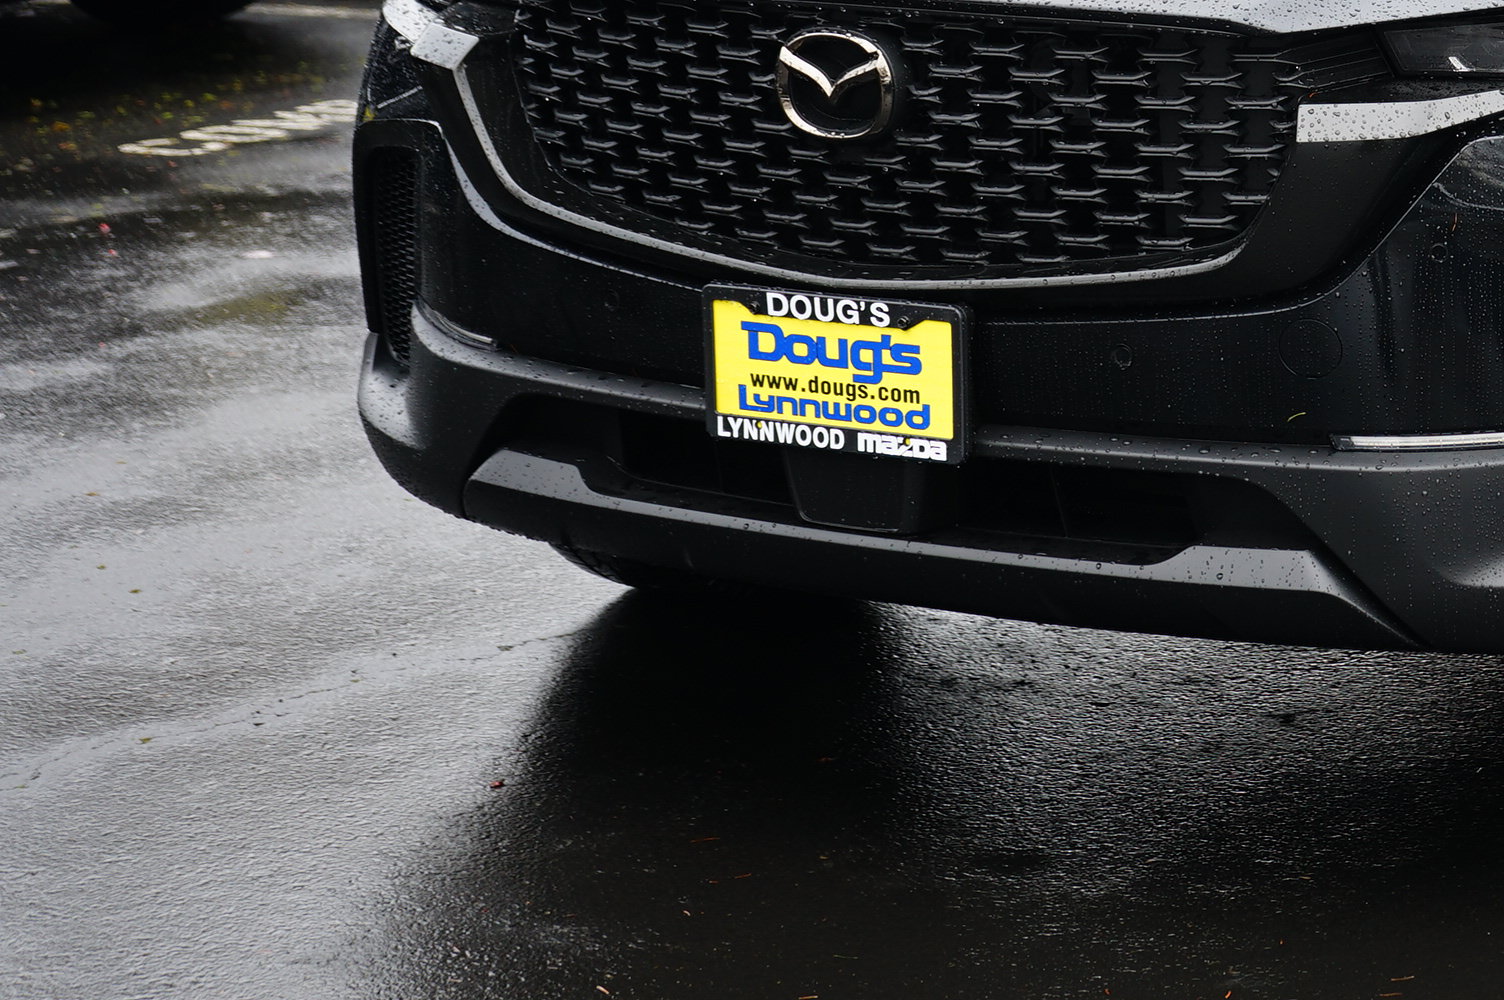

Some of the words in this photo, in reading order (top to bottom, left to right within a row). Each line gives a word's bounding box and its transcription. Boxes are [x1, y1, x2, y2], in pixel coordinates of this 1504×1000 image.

[766, 292, 891, 328] DOUG'S
[741, 321, 923, 384] Doug's
[750, 372, 921, 405] www.dougs.com
[738, 384, 931, 430] Lynnwood
[716, 415, 846, 451] LYNNWOOD
